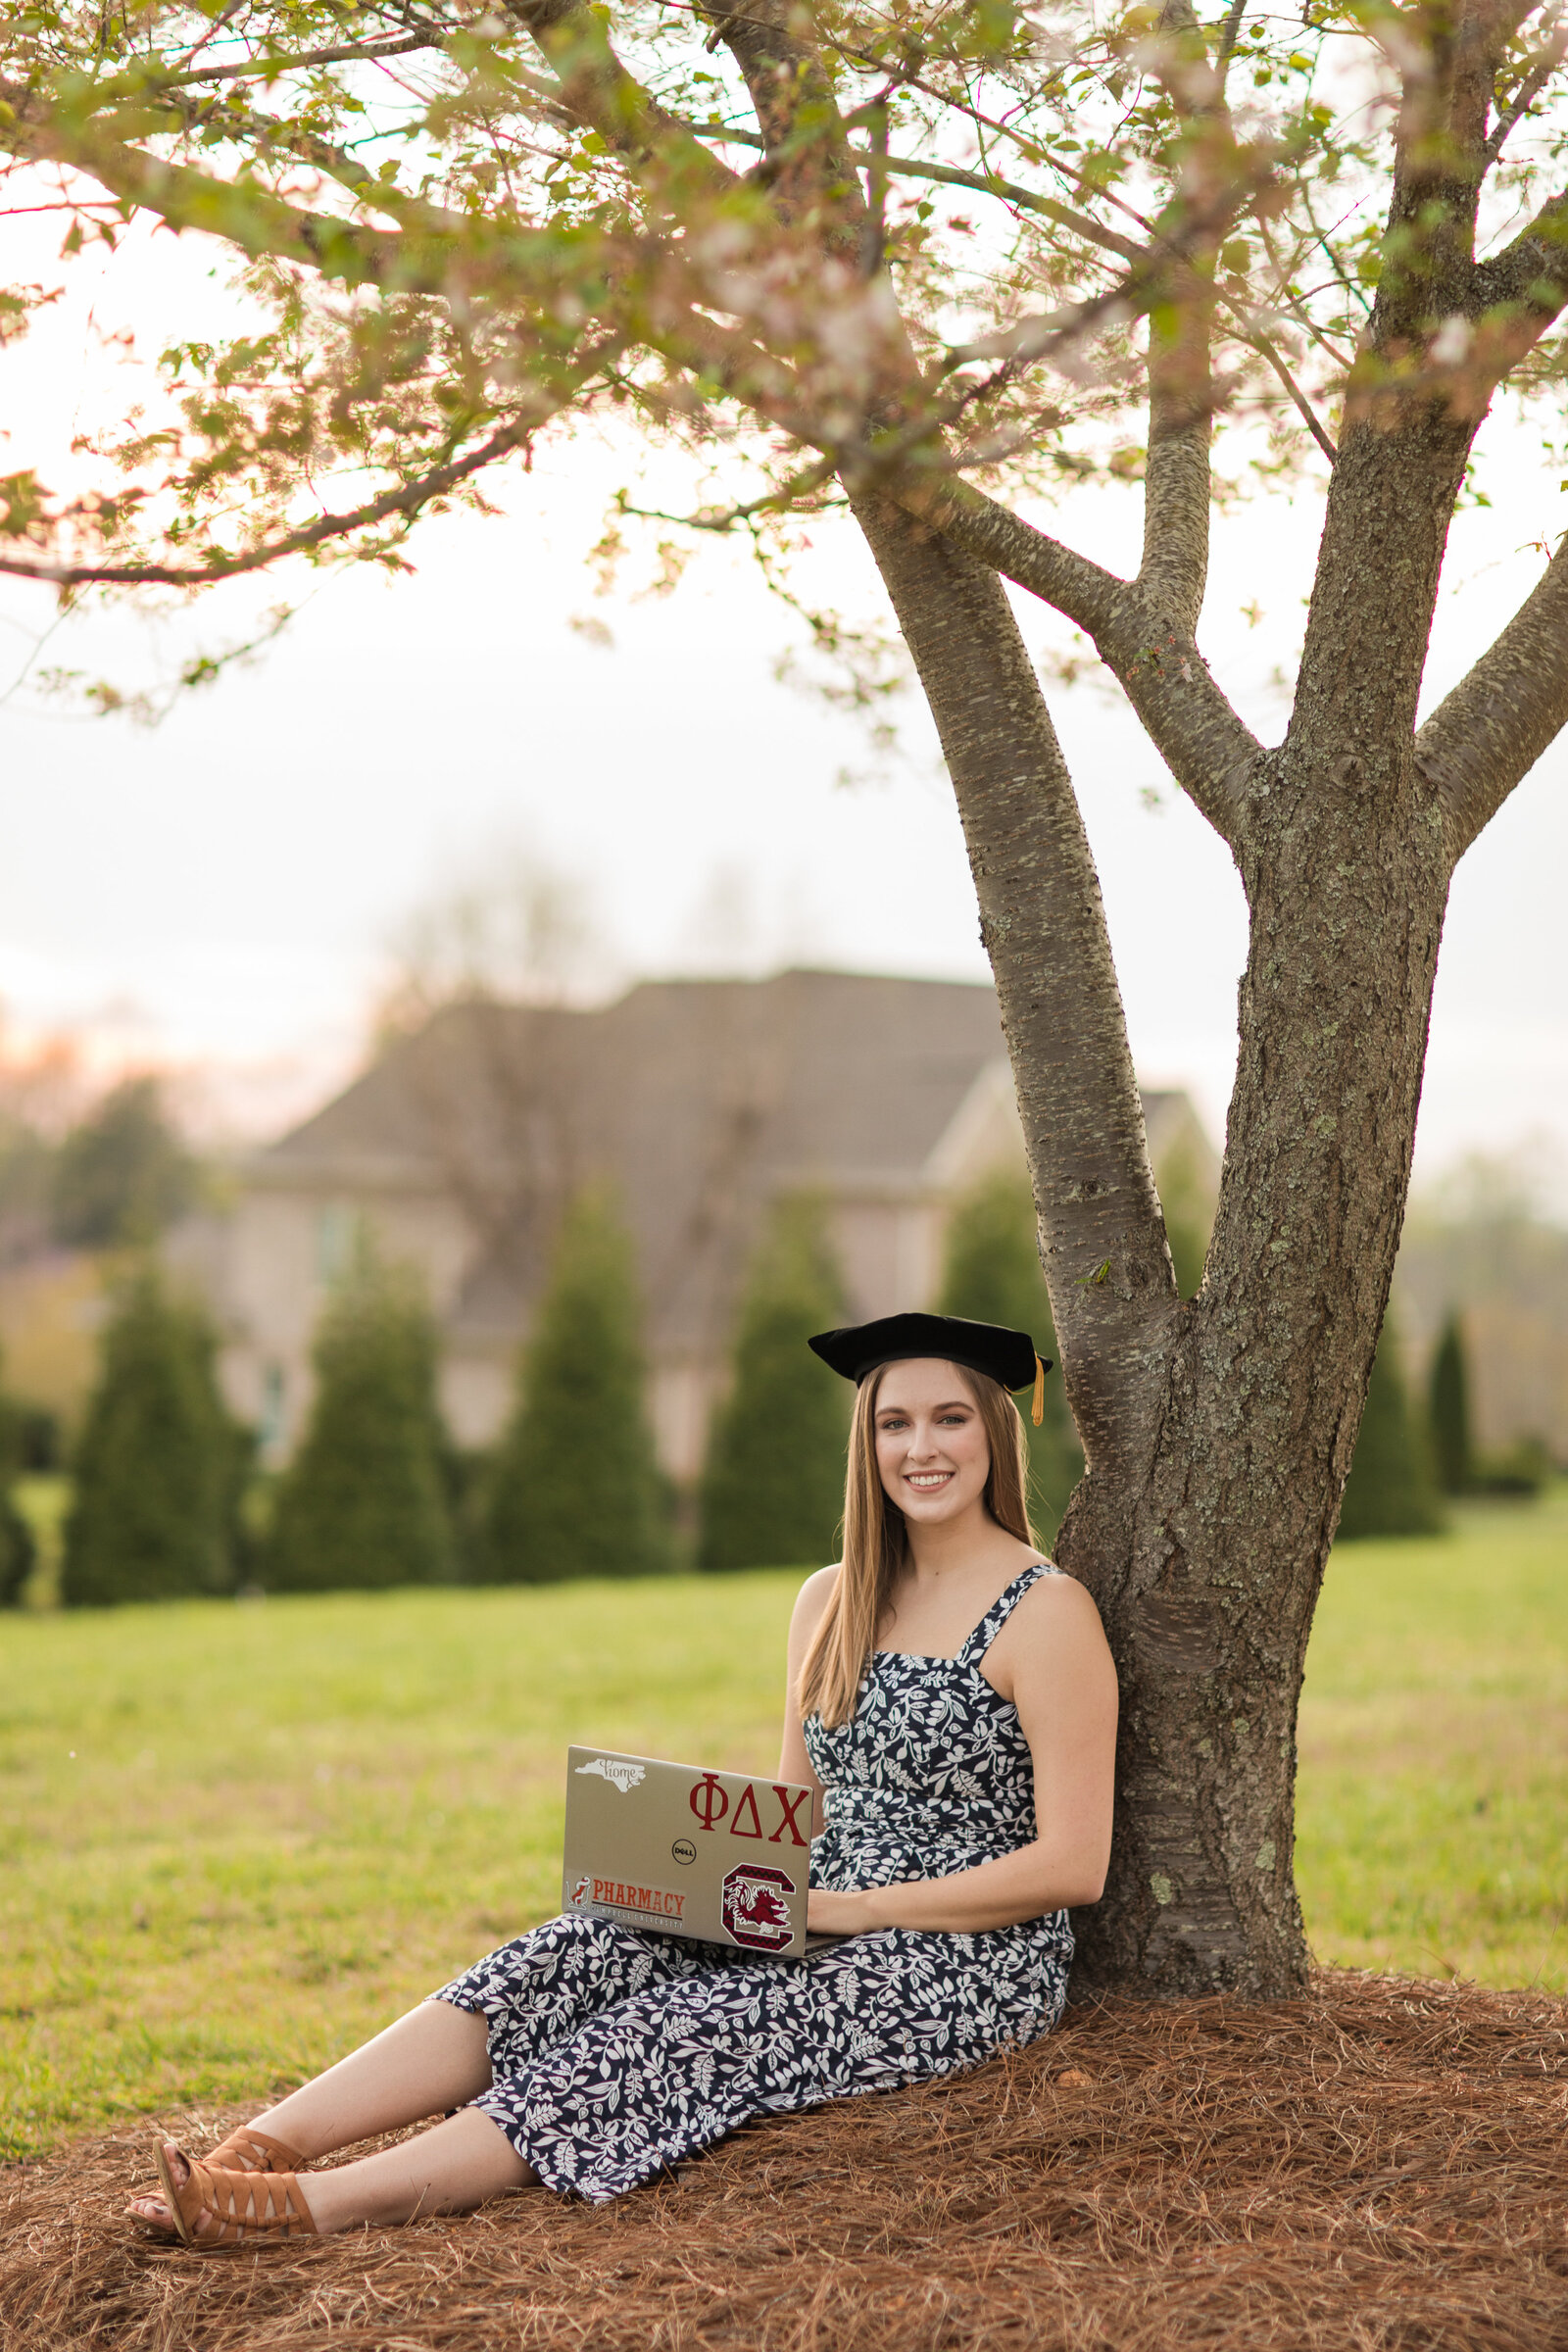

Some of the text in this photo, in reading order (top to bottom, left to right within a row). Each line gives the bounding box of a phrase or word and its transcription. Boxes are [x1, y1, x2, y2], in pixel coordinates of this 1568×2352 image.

[600, 1760, 636, 1787] home
[674, 1847, 694, 1857] DELL
[593, 1879, 686, 1916] PHARMACY
[634, 1914, 684, 1930] UNIVERSITY
